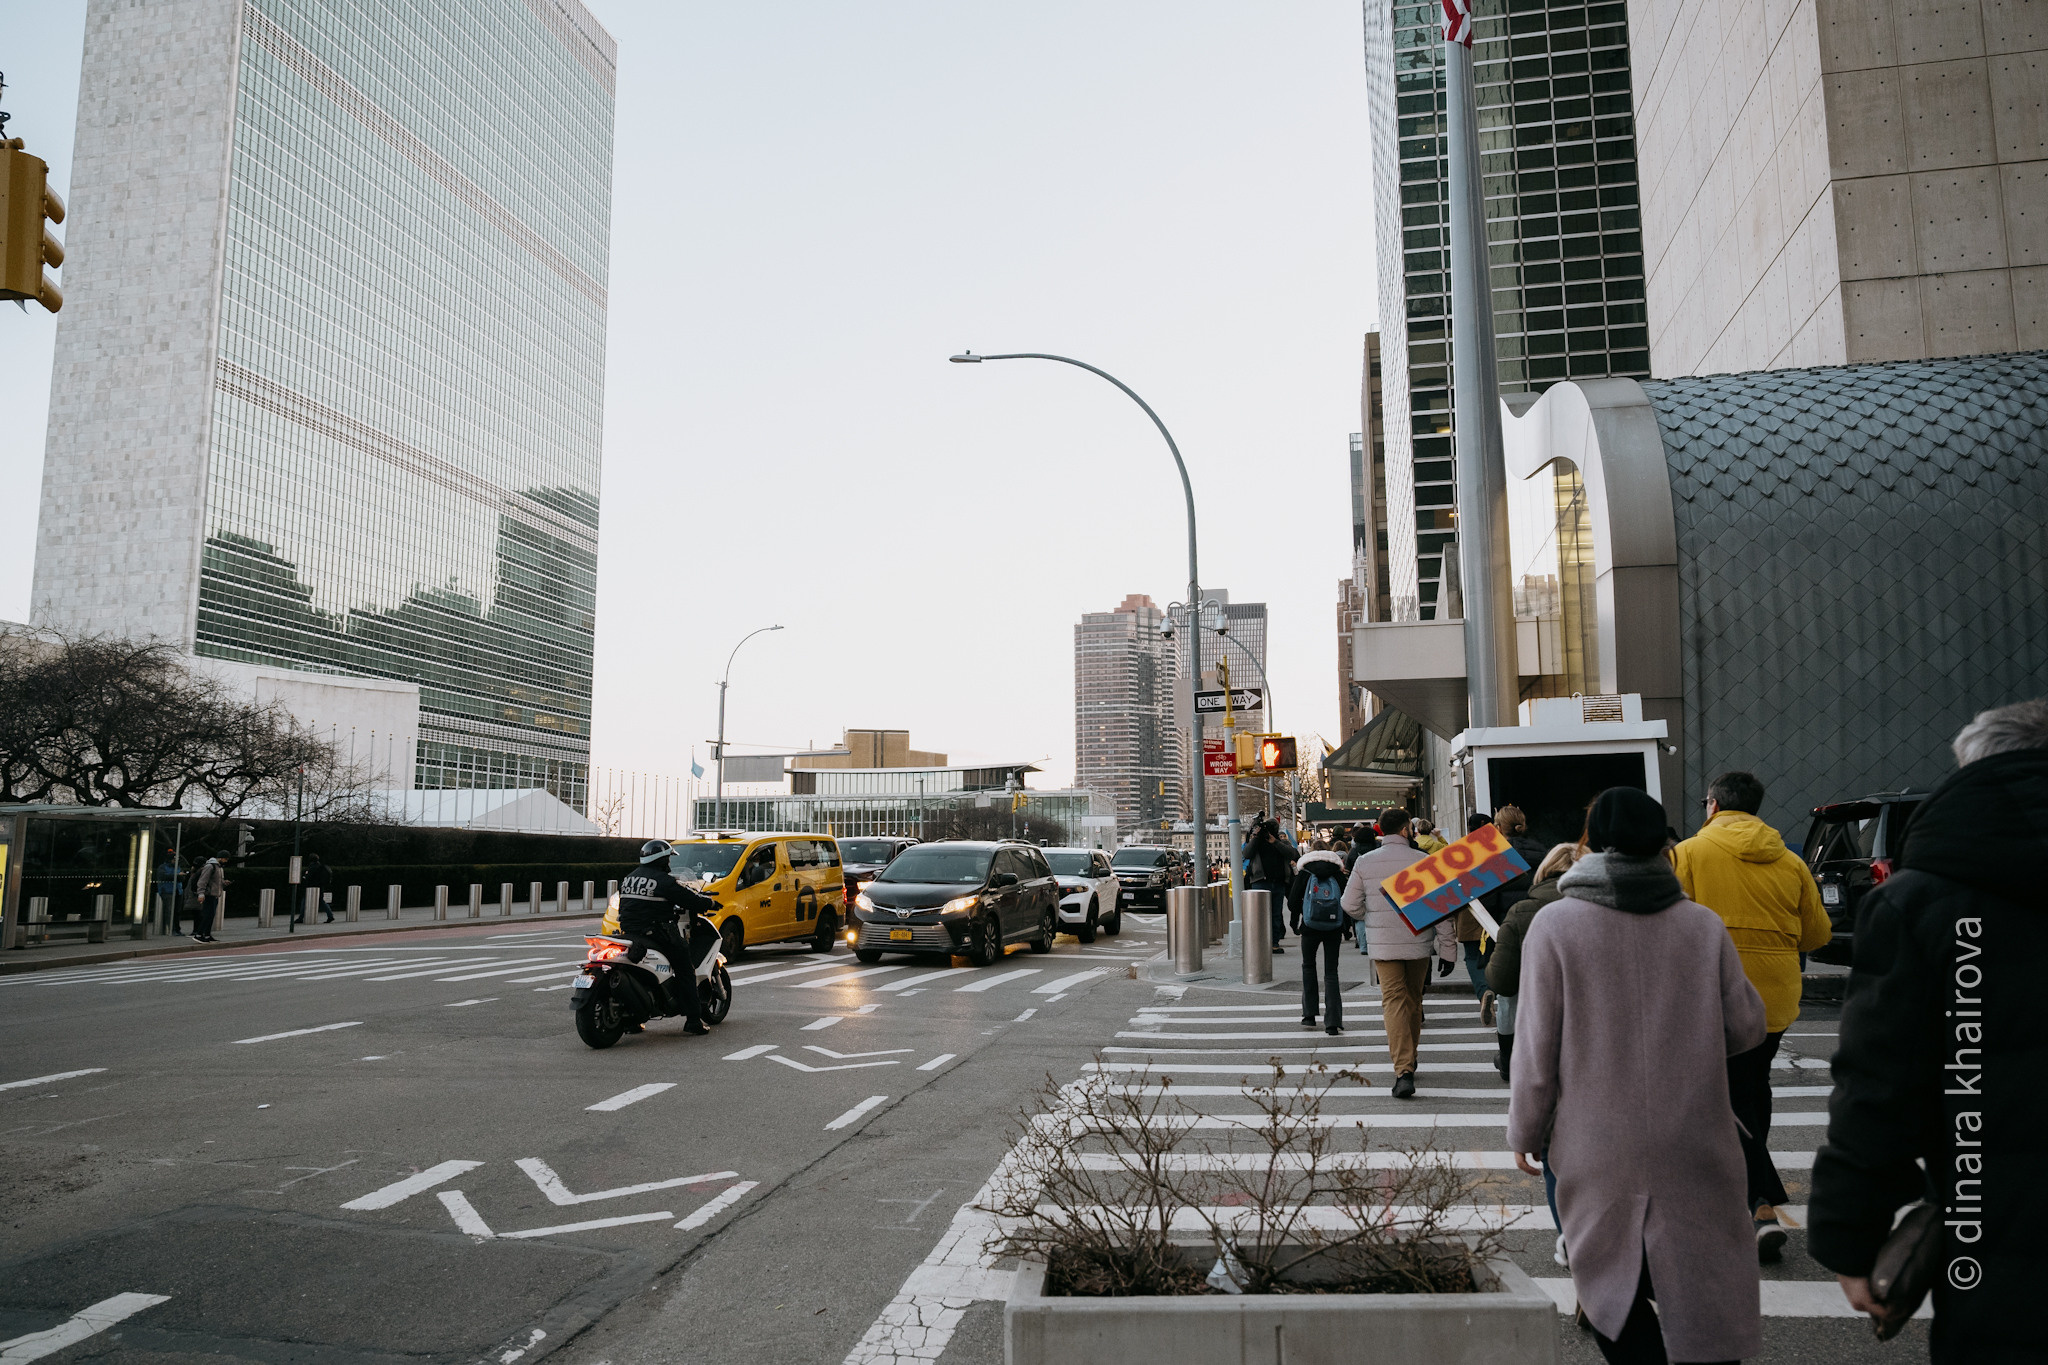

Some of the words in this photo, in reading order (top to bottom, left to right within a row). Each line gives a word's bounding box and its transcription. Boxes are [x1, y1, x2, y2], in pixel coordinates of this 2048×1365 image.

[1200, 697, 1220, 707] ONE
[1231, 695, 1253, 705] WAY
[1209, 760, 1233, 768] WRONG
[1394, 824, 1499, 903] STOP
[621, 876, 658, 891] NYPD
[1422, 853, 1524, 914] WAR
[620, 886, 655, 897] POLICE
[760, 899, 772, 908] NYC
